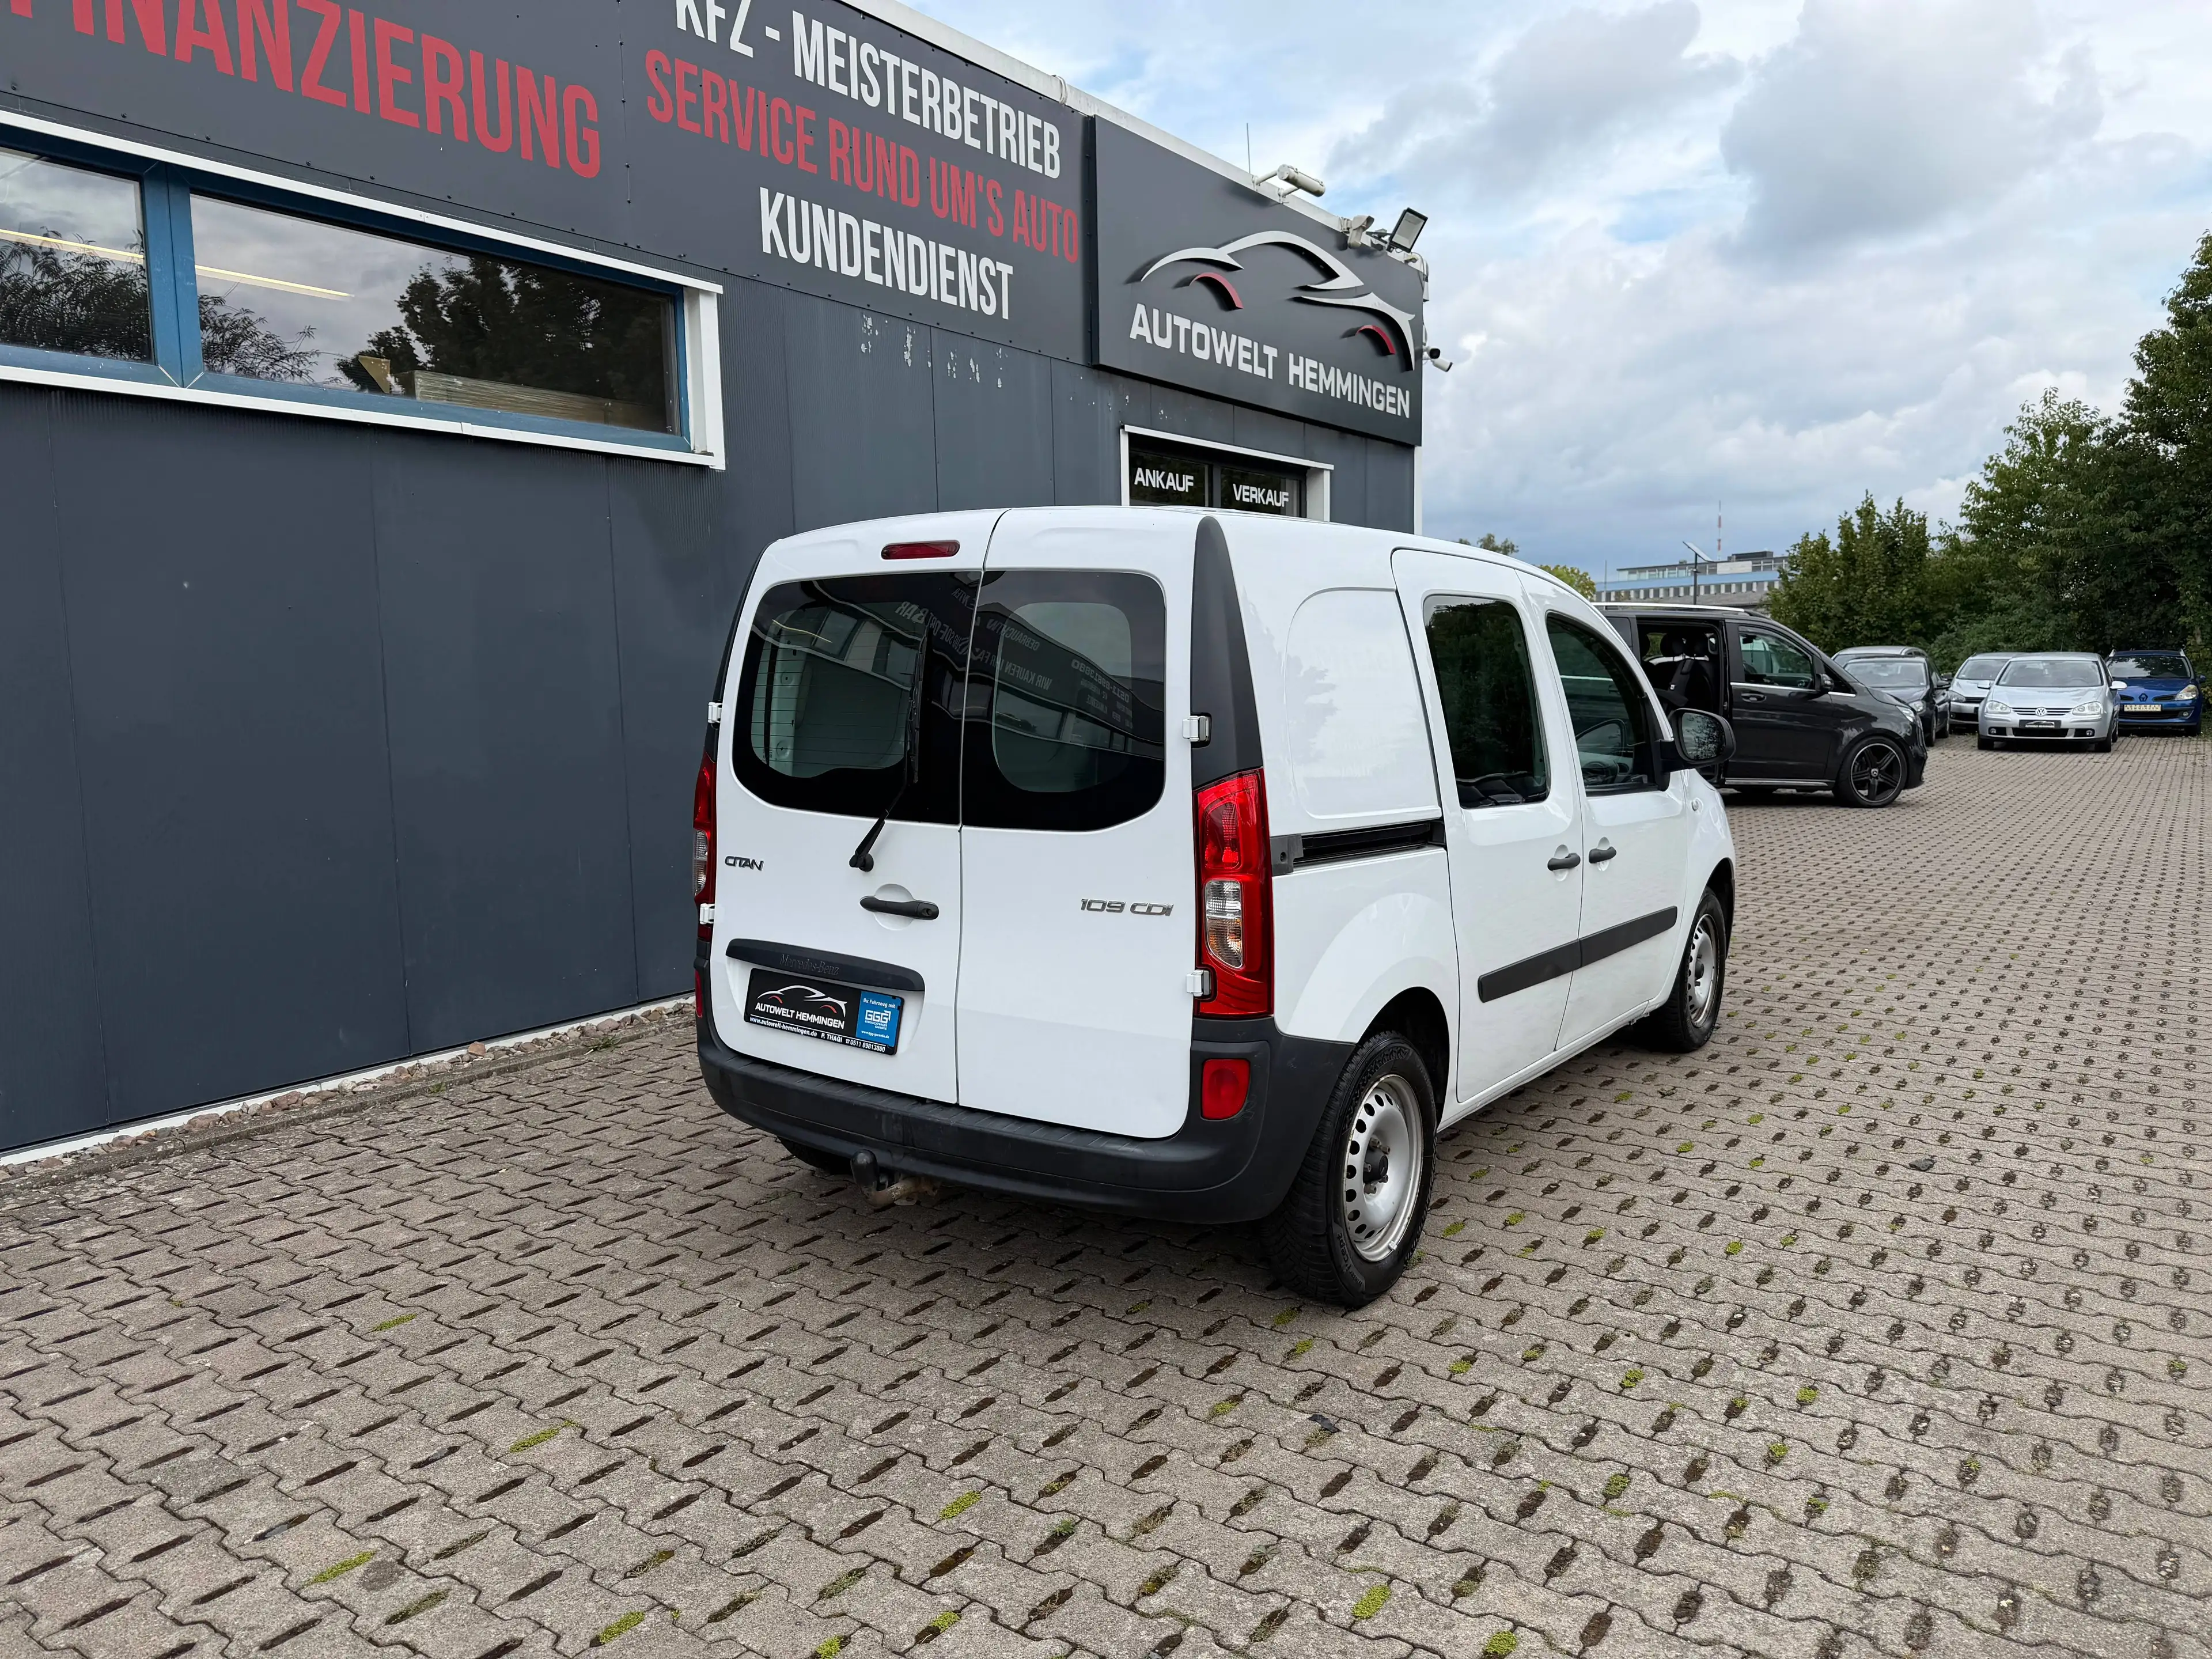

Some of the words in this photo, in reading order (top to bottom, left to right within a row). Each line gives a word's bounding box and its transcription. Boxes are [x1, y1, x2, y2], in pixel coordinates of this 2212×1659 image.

[11, 0, 600, 177] ANZIERUNG
[793, 10, 1060, 178] MEISTERBETRIEB
[646, 50, 817, 173] SERVICE
[829, 119, 919, 207] RUND
[930, 158, 1003, 236] UM'S
[1014, 191, 1078, 262] AUTO
[760, 187, 1013, 319] KUNDENDIENST
[1130, 304, 1277, 379] AUTOWELT
[1289, 353, 1409, 418] HEMMINGEN
[1135, 468, 1193, 492] ANKAUF
[1233, 484, 1289, 507] VERKAUF
[725, 855, 764, 871] CITAN
[1081, 899, 1125, 913] 109
[1130, 903, 1173, 916] CDI
[779, 954, 839, 975] Mercedes-Benz
[755, 1002, 795, 1018] AUTOWELT
[796, 1011, 844, 1029] HEMMINGEN
[869, 999, 887, 1008] Fahrzeug
[865, 1009, 889, 1024] GGG
[749, 1016, 817, 1037] www.autowelt-hemmingen.de
[827, 1034, 843, 1043] THAQI
